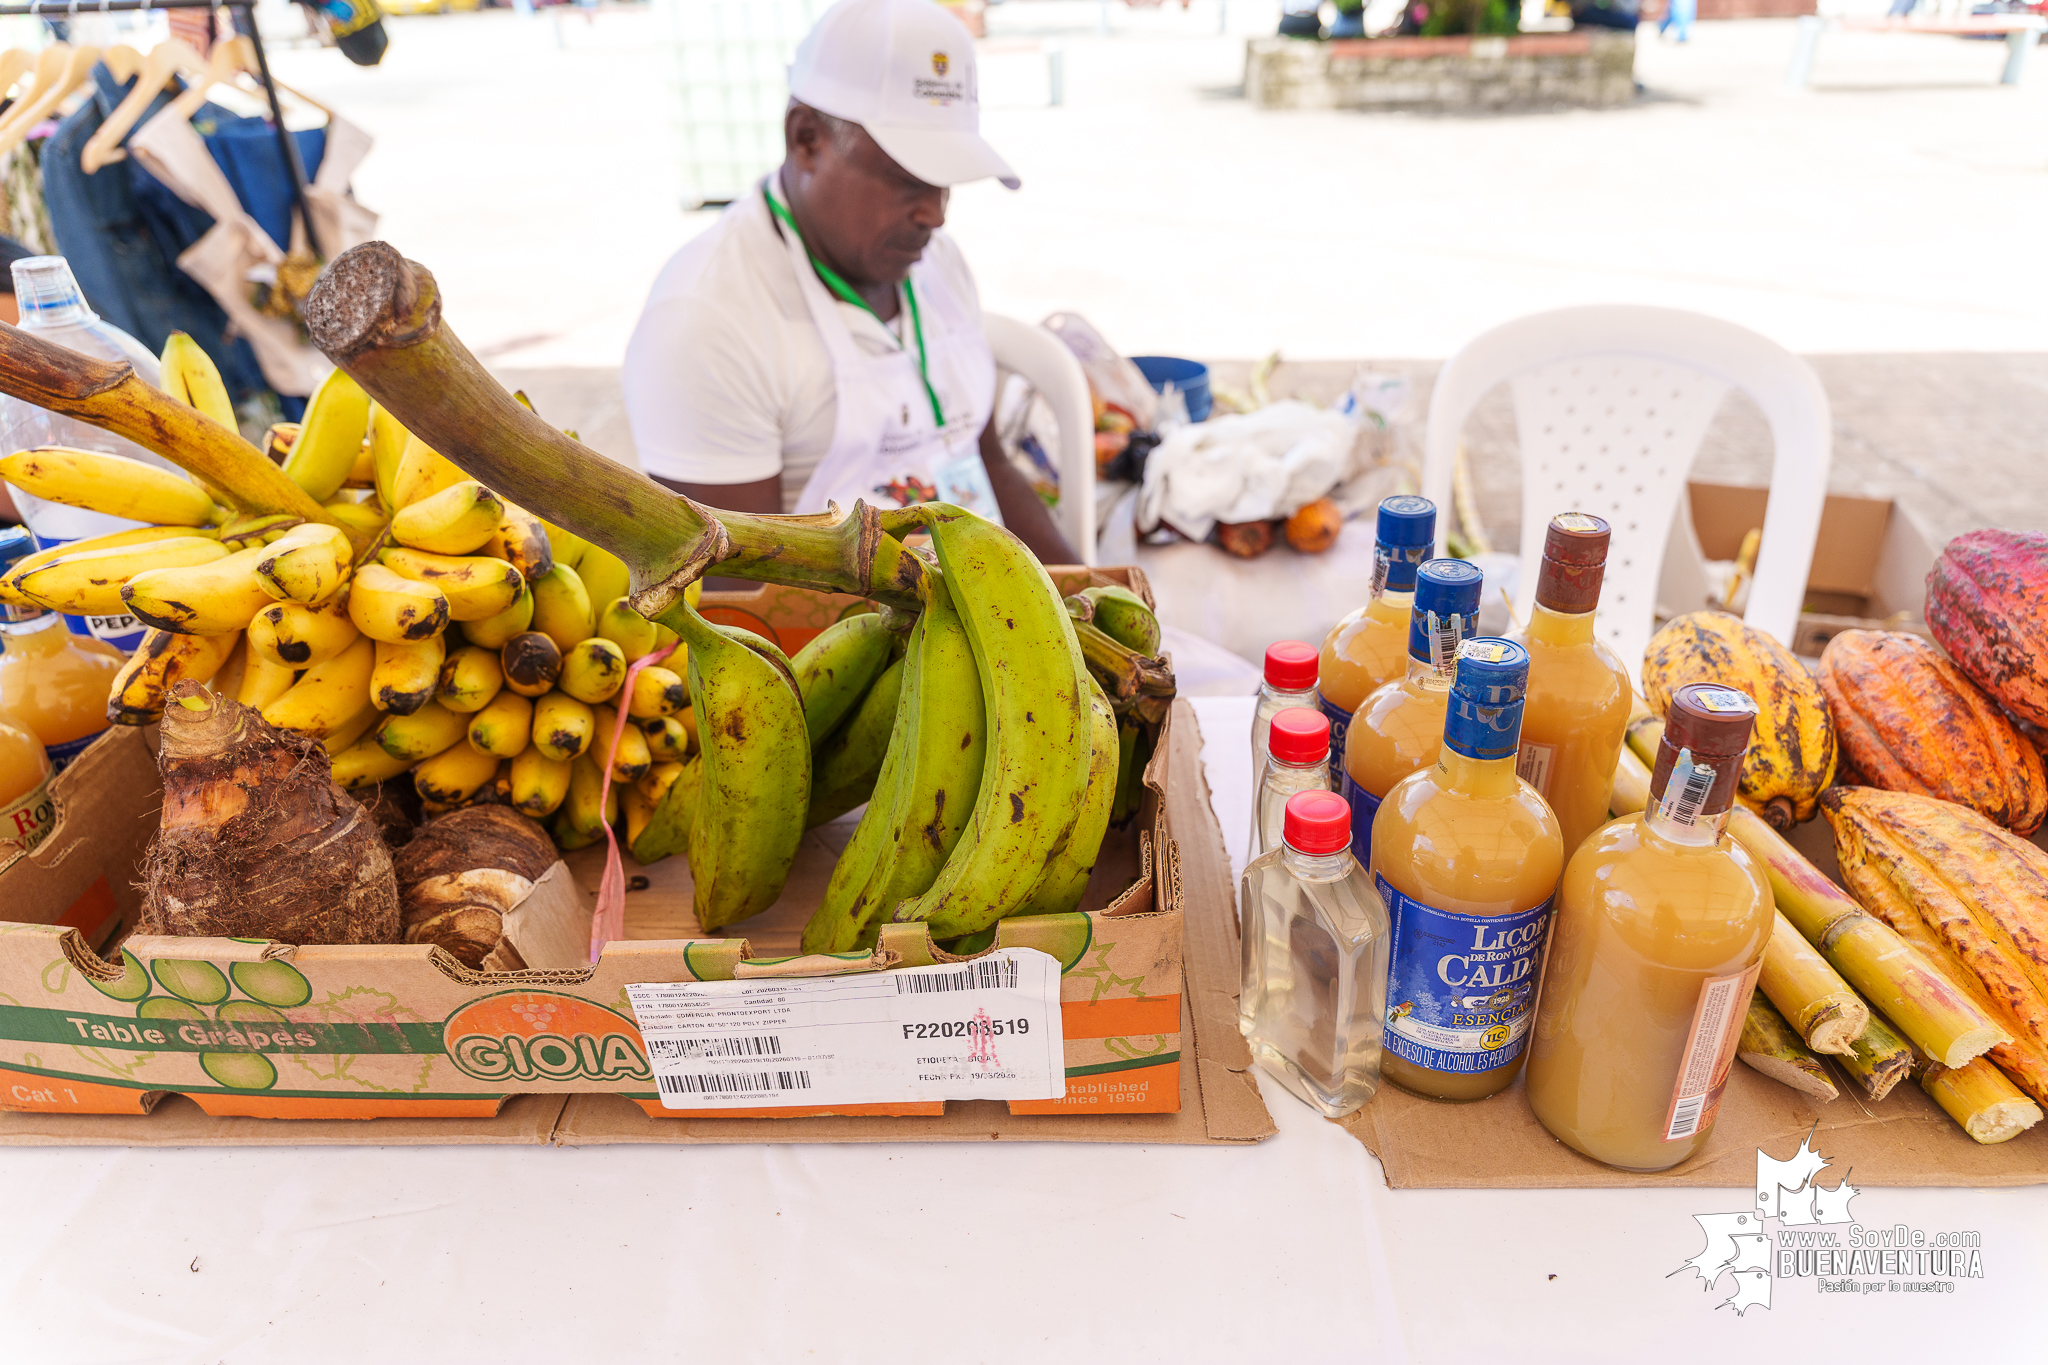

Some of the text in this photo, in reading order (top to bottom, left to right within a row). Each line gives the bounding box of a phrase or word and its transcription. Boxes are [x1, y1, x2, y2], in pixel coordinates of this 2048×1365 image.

[91, 616, 146, 629] PEP
[1470, 914, 1547, 950] LICOR
[1470, 953, 1485, 962] DE
[1486, 951, 1512, 962] RON
[1512, 940, 1535, 957] VIEJO
[1492, 994, 1510, 1005] 1928
[1452, 998, 1530, 1026] ESENCIAL
[66, 1017, 317, 1049] Table Grapes
[455, 1035, 650, 1077] GIOIA
[967, 1055, 991, 1063] GIOA
[1383, 1030, 1391, 1049] EL
[1392, 1038, 1422, 1063] EXCESO
[1424, 1049, 1436, 1067] DE
[1436, 1052, 1475, 1071] ALCOHOL
[1477, 1053, 1489, 1070] ES
[11, 1085, 79, 1104] Cat 1
[1053, 1091, 1147, 1105] since 1950
[1063, 1081, 1149, 1095] stablished
